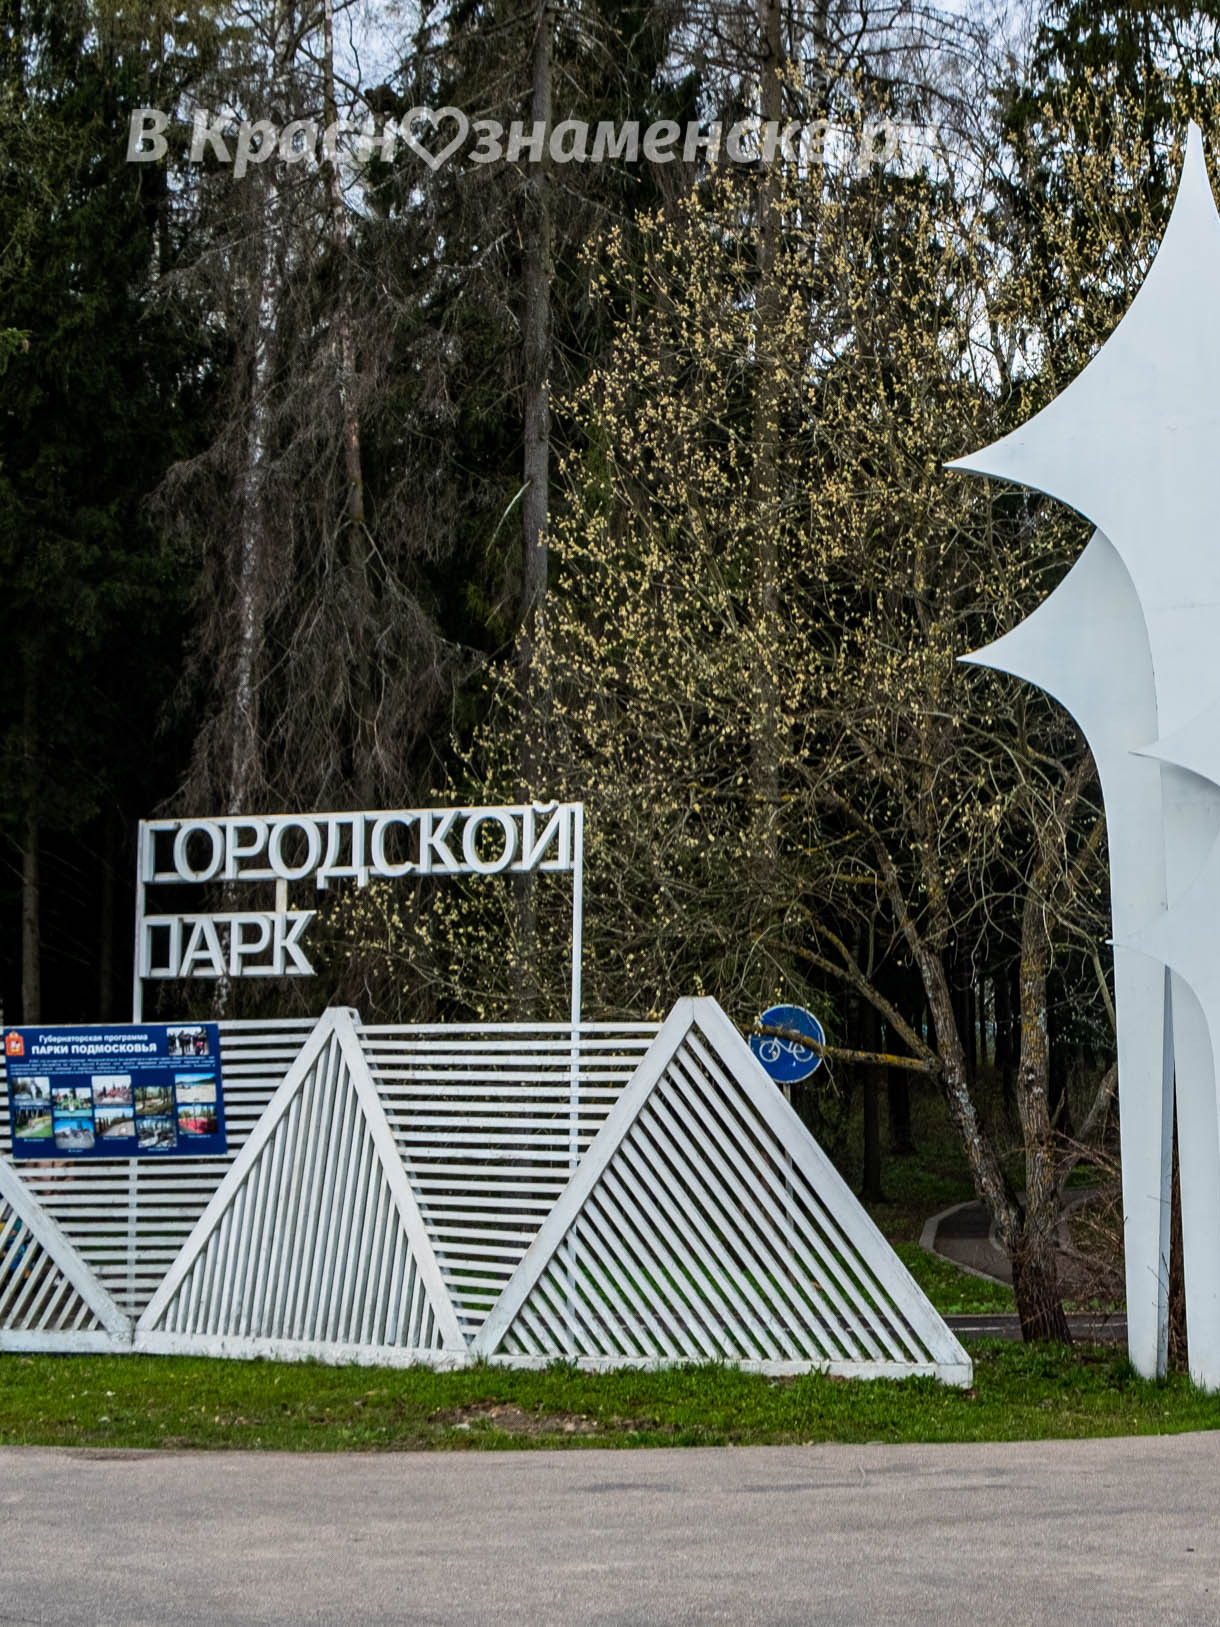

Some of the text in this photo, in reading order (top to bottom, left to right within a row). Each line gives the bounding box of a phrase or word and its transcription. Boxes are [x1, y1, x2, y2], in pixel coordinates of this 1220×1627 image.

[141, 800, 572, 890] ГОРОДСКОЙ
[139, 911, 318, 978] ПАРК
[31, 1042, 158, 1056] ПАРКИ ПОДМОСКОВЬЯ
[38, 1033, 149, 1045] Губернаторская программа
